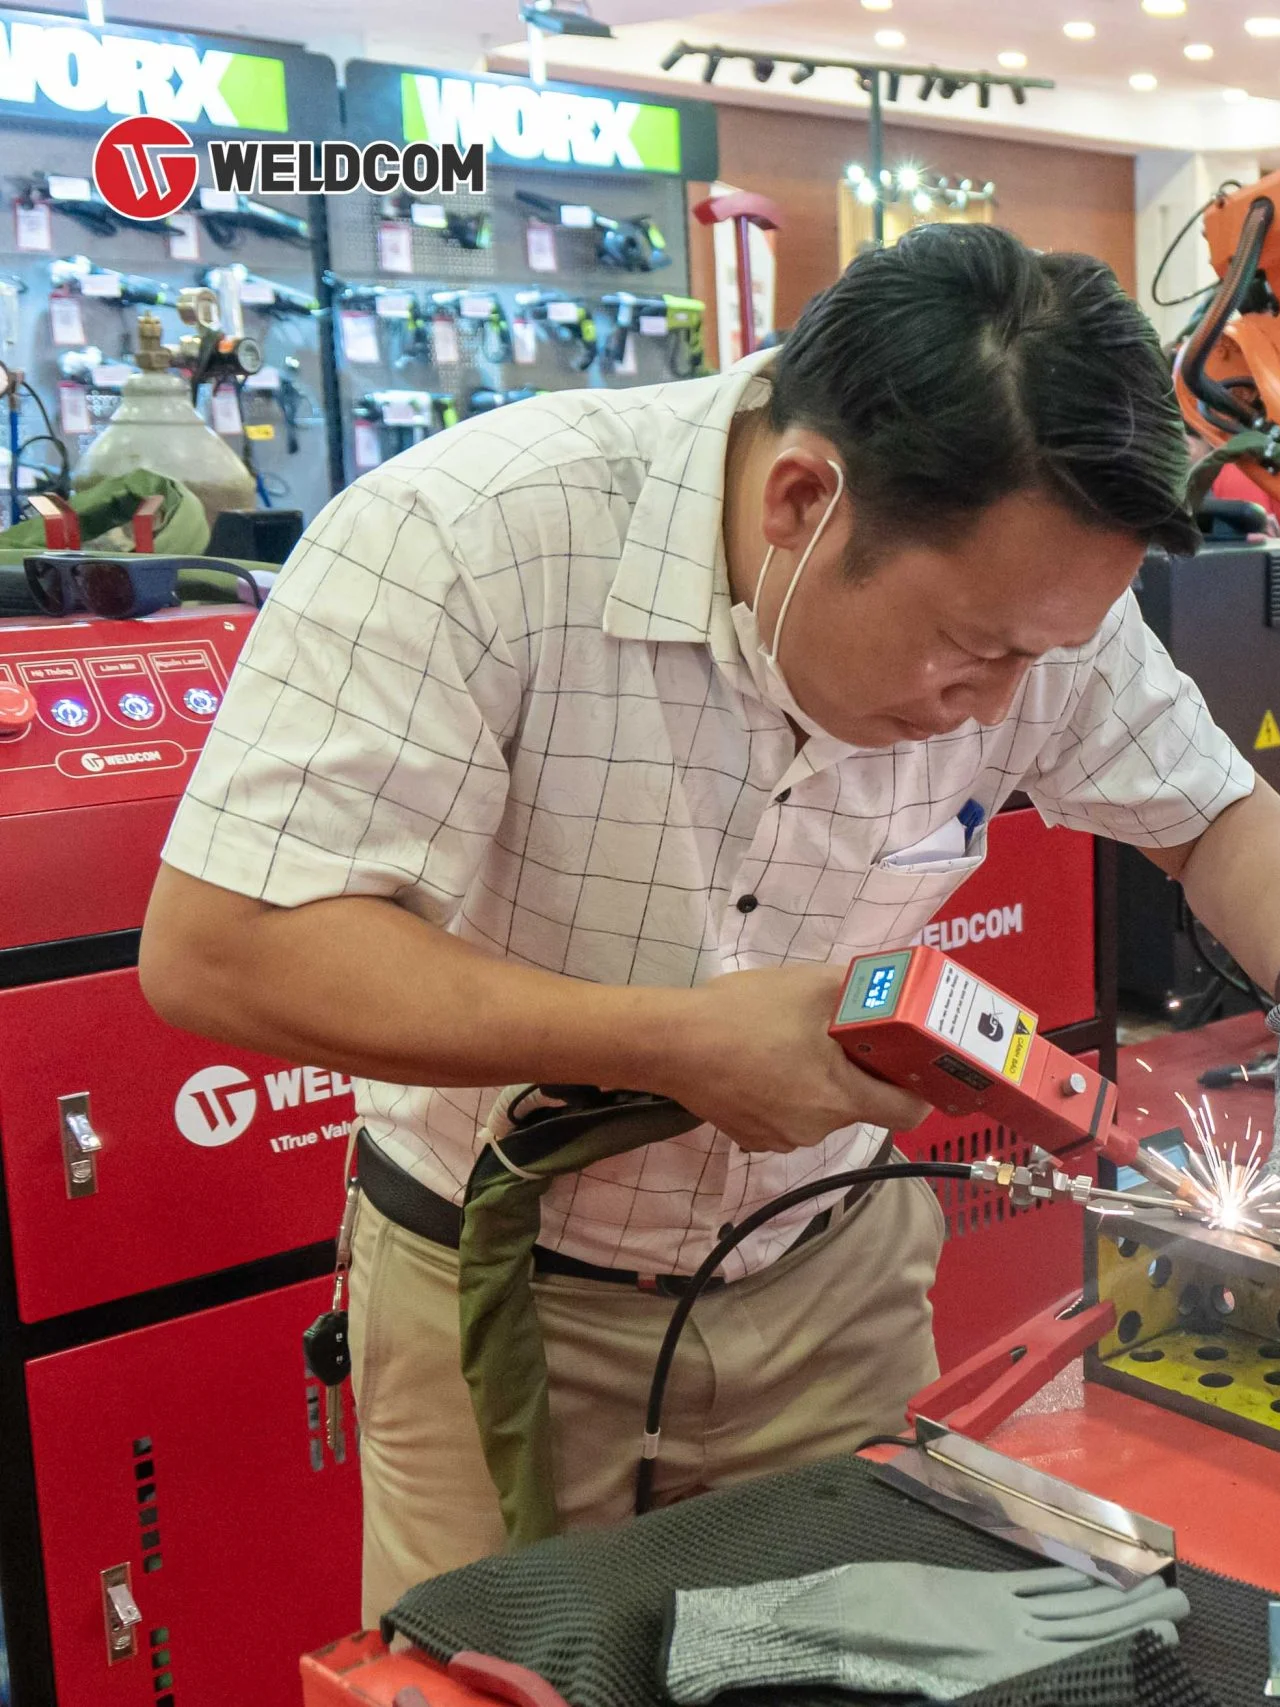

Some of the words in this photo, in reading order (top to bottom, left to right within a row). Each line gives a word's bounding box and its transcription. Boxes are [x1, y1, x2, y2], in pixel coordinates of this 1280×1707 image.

[415, 74, 645, 169] WORX
[104, 750, 162, 766] WELDCOM
[264, 1065, 354, 1112] WEL
[278, 1132, 318, 1152] True
